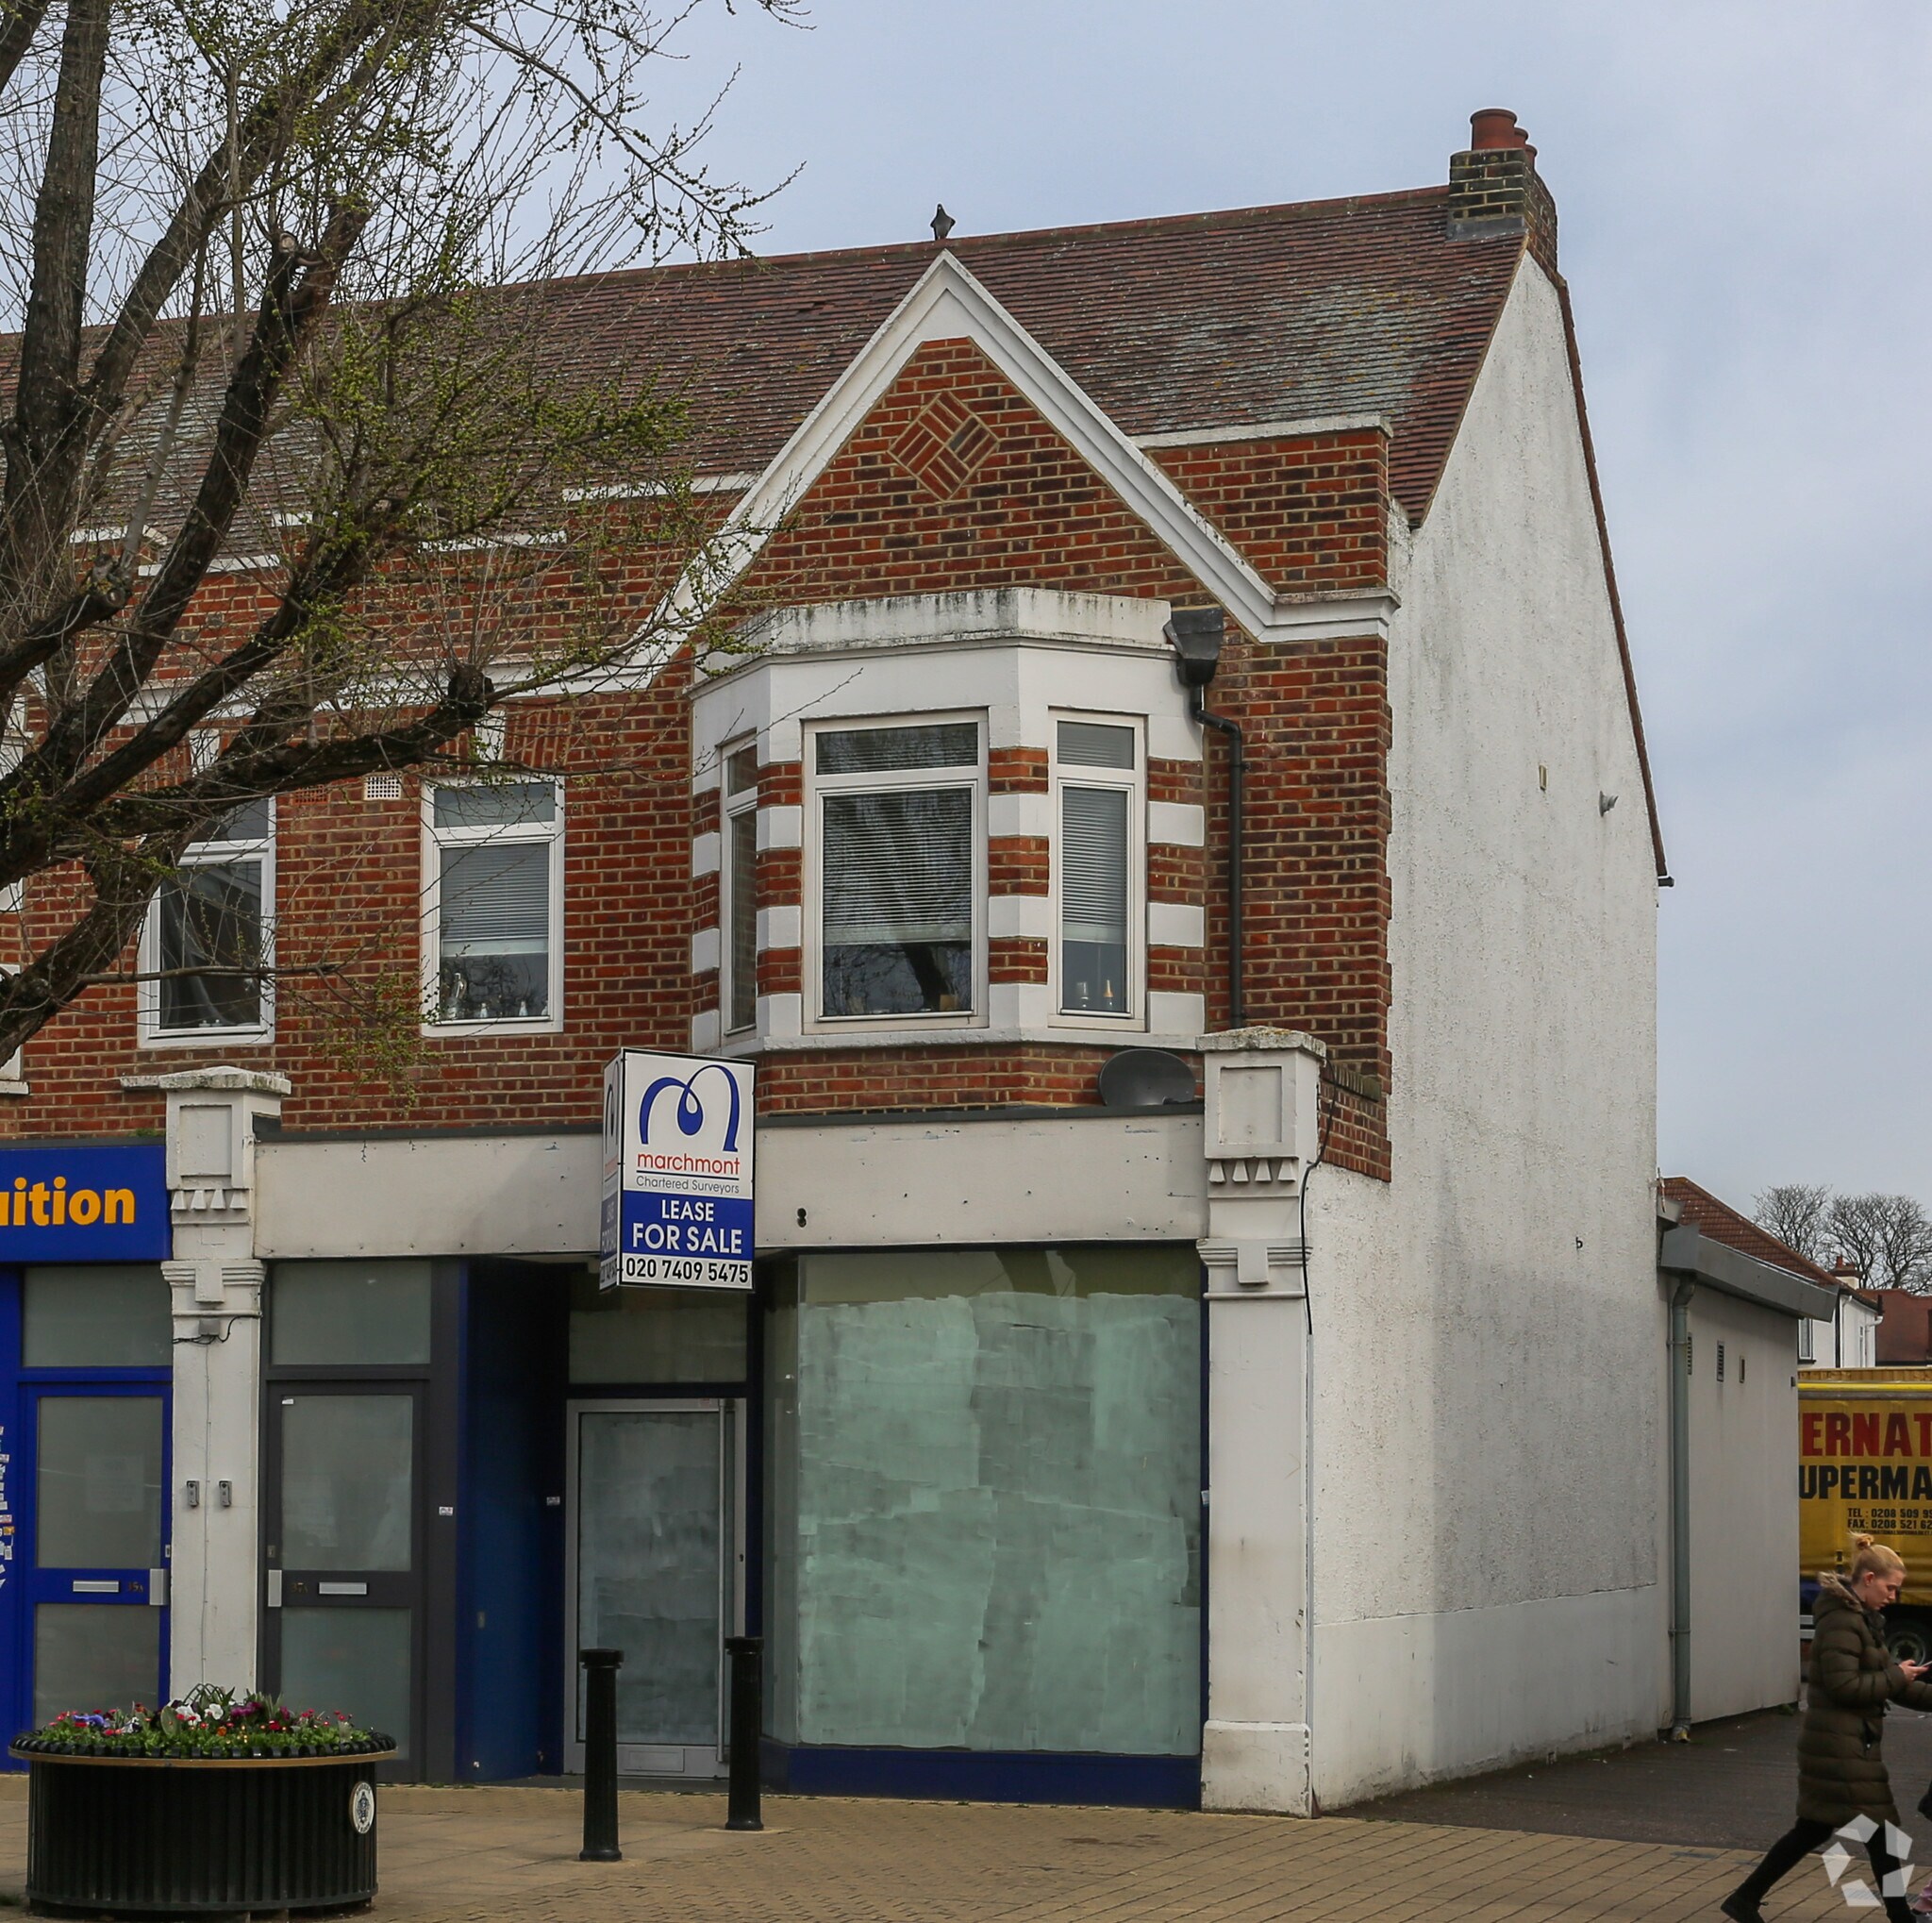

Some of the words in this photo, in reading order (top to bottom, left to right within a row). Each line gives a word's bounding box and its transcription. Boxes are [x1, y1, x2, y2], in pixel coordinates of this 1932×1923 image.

[637, 1152, 741, 1176] marchmont
[636, 1175, 689, 1190] Chartered
[691, 1179, 740, 1195] Surveyors
[661, 1199, 714, 1222] LEASE
[633, 1222, 680, 1250] FOR
[686, 1226, 742, 1254] SALE
[625, 1257, 657, 1278] 020
[662, 1260, 703, 1280] 7409
[708, 1262, 748, 1283] 5475
[1871, 1509, 1896, 1517] 0208
[1900, 1509, 1919, 1518] 509
[1871, 1519, 1896, 1529] 0208
[1900, 1520, 1917, 1529] 521
